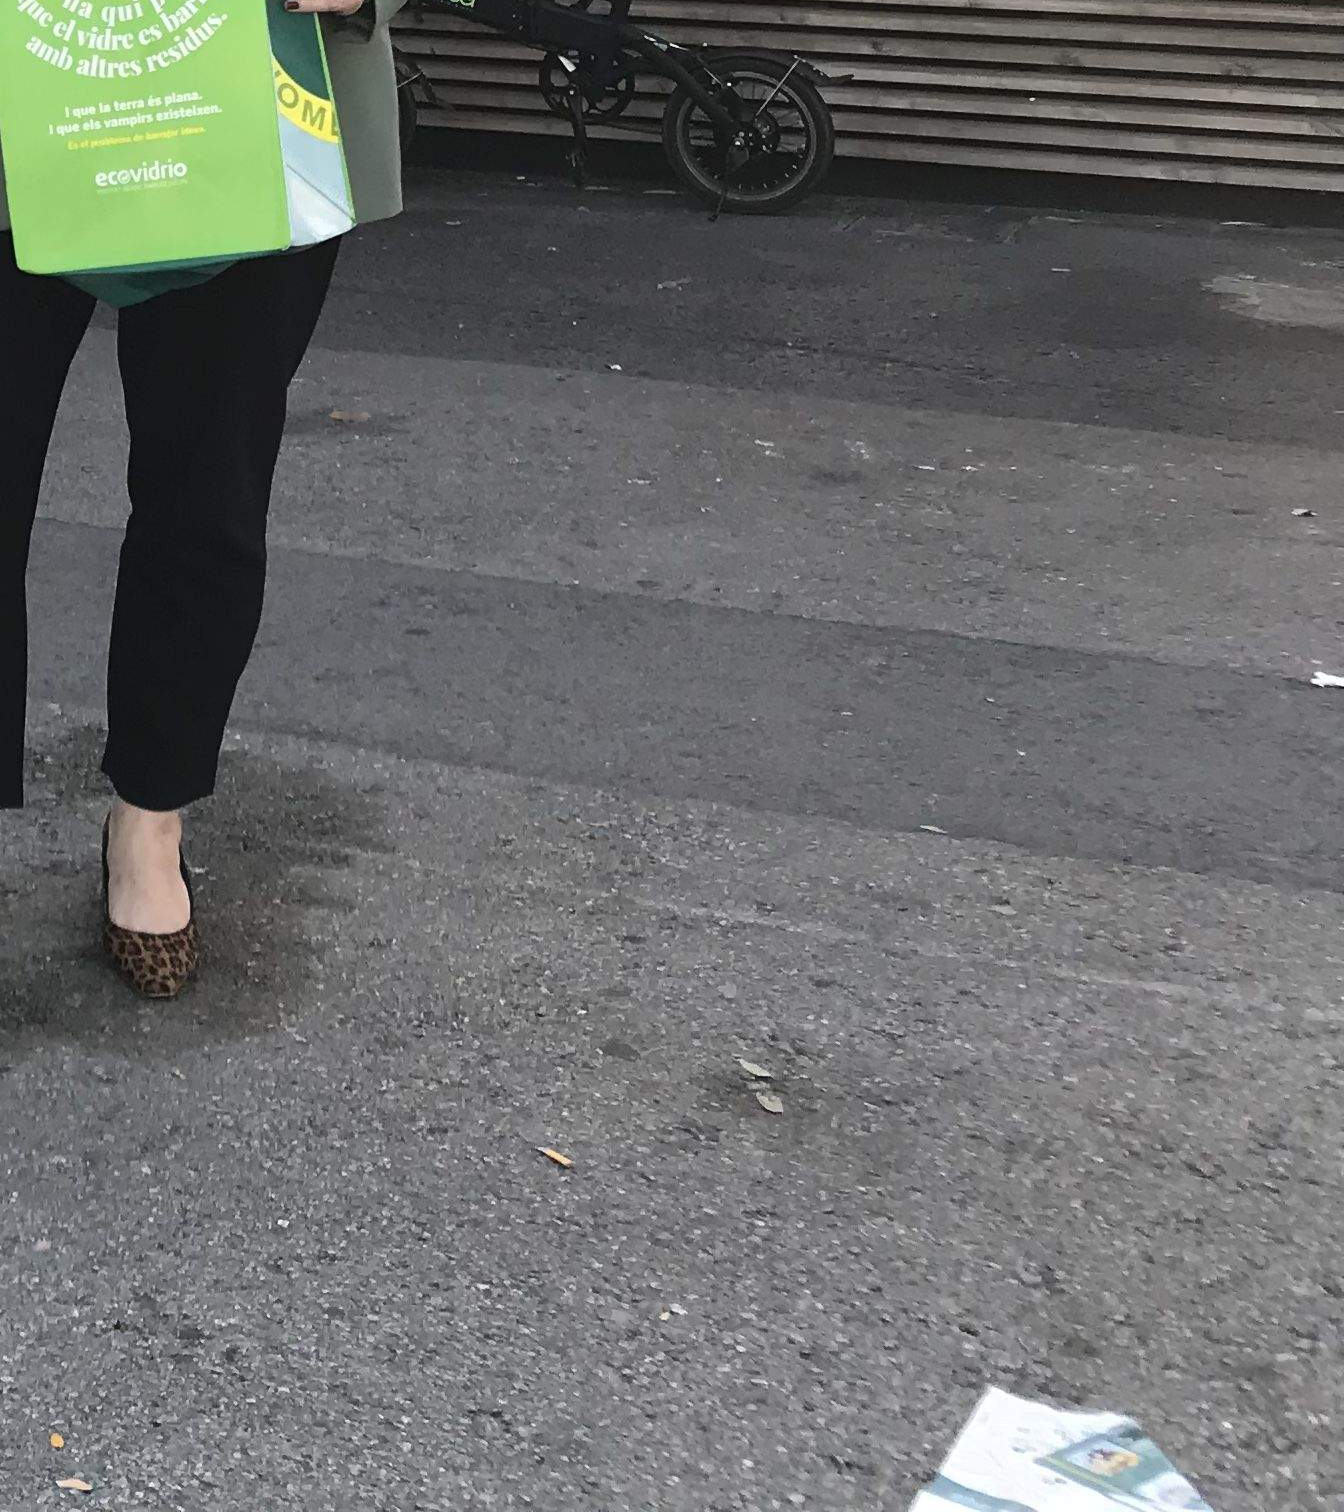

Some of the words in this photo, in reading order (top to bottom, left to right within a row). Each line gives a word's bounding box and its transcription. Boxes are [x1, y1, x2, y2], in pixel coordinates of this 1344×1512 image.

[25, 36, 73, 71] amb
[76, 55, 143, 78] altres
[146, 13, 228, 72] residus.
[53, 20, 76, 41] el
[77, 26, 133, 50] vidre
[139, 24, 162, 45] es
[73, 106, 96, 118] que
[99, 103, 111, 113] la
[114, 100, 144, 112] terra
[148, 95, 162, 107] és
[165, 91, 203, 106] plana.
[57, 122, 80, 136] que
[83, 119, 101, 130] els
[104, 112, 153, 128] vampirs
[156, 104, 222, 121] existeixen.
[95, 158, 187, 186] ecovidrio
